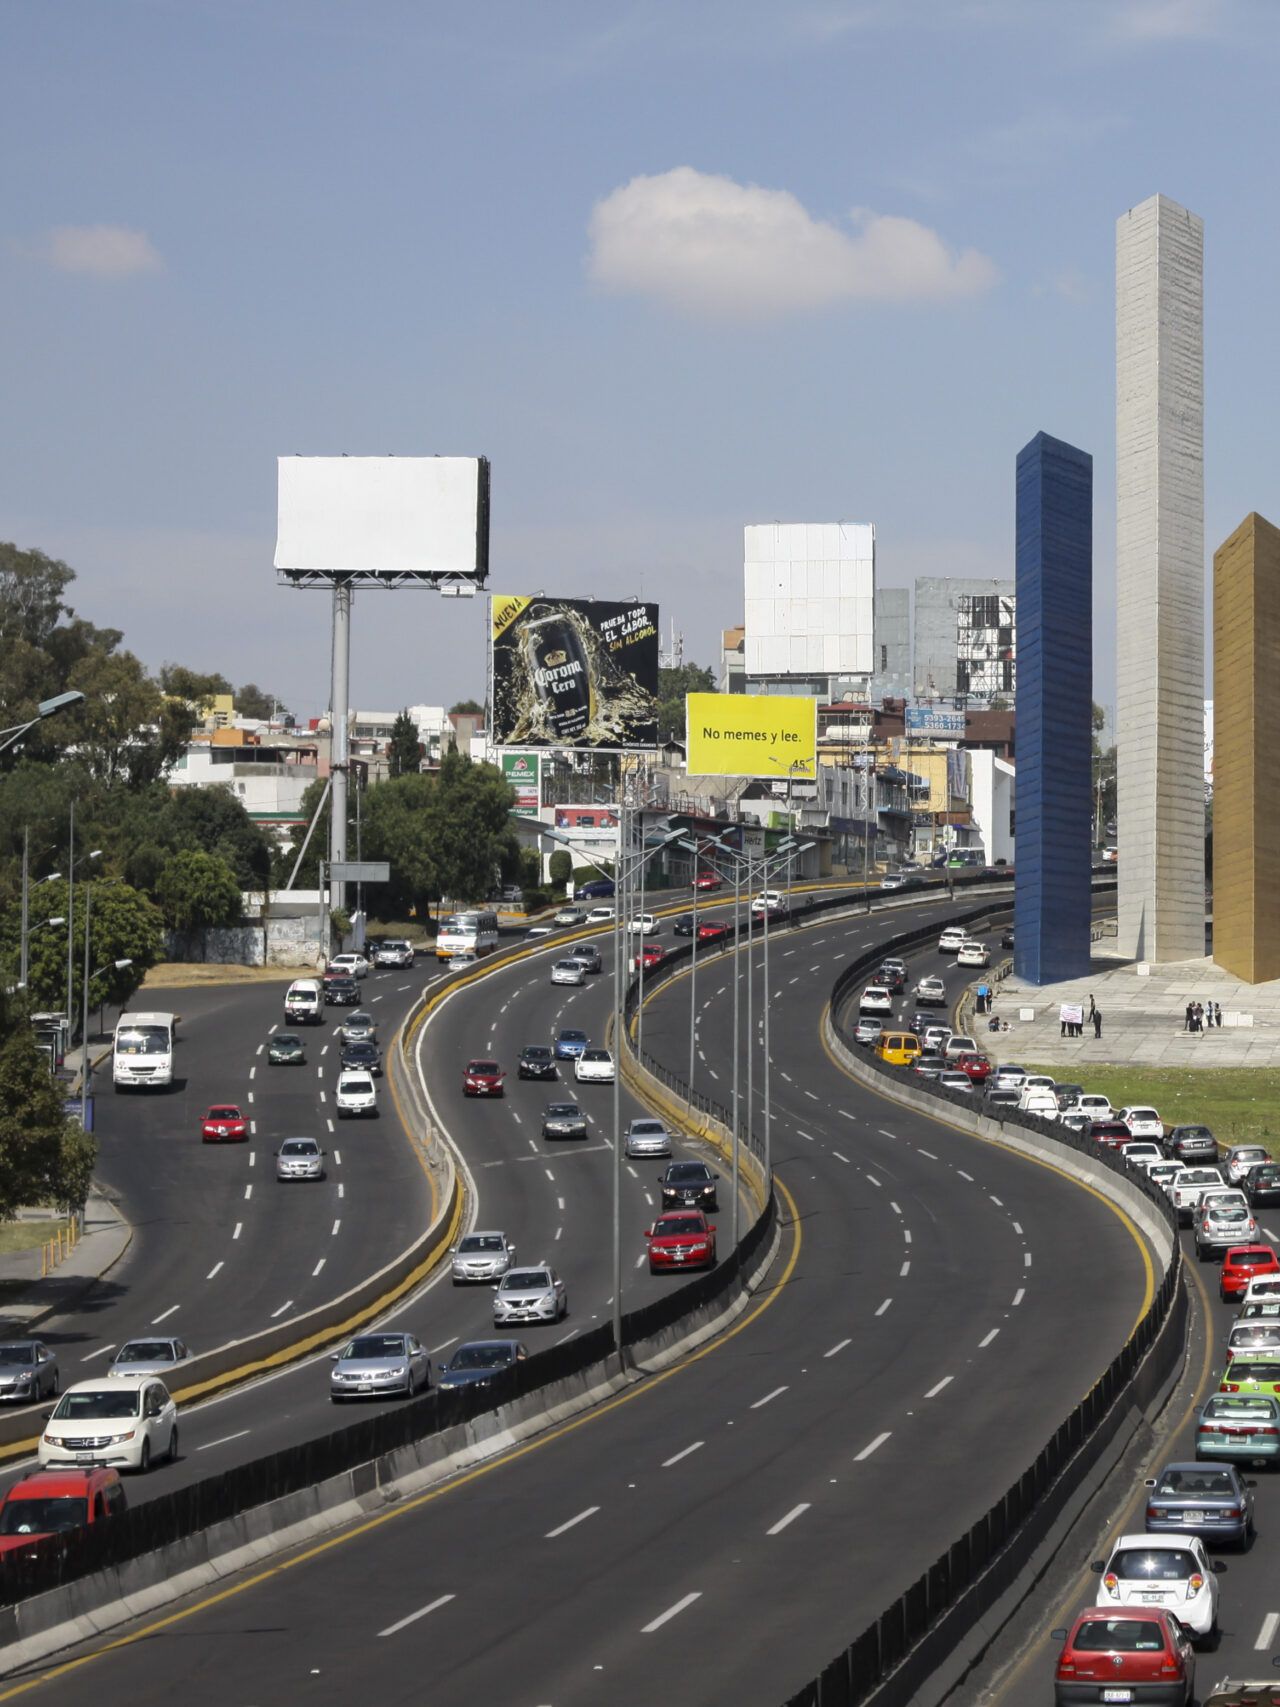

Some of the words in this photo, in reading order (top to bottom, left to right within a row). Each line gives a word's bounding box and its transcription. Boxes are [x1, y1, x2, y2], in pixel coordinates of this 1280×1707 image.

[494, 598, 523, 630] NUEVA
[600, 616, 625, 631] PRUEBA
[627, 606, 646, 619] TODO
[605, 630, 618, 642] EL
[609, 640, 623, 652] SIN
[625, 626, 657, 646] ALCOHOL
[535, 660, 583, 687] Corona
[552, 680, 576, 694] Cero
[703, 728, 720, 740] No
[724, 730, 767, 742] memes
[770, 732, 778, 744] y
[781, 730, 802, 742] lee.
[792, 760, 805, 769] 45
[744, 837, 762, 846] Hertz
